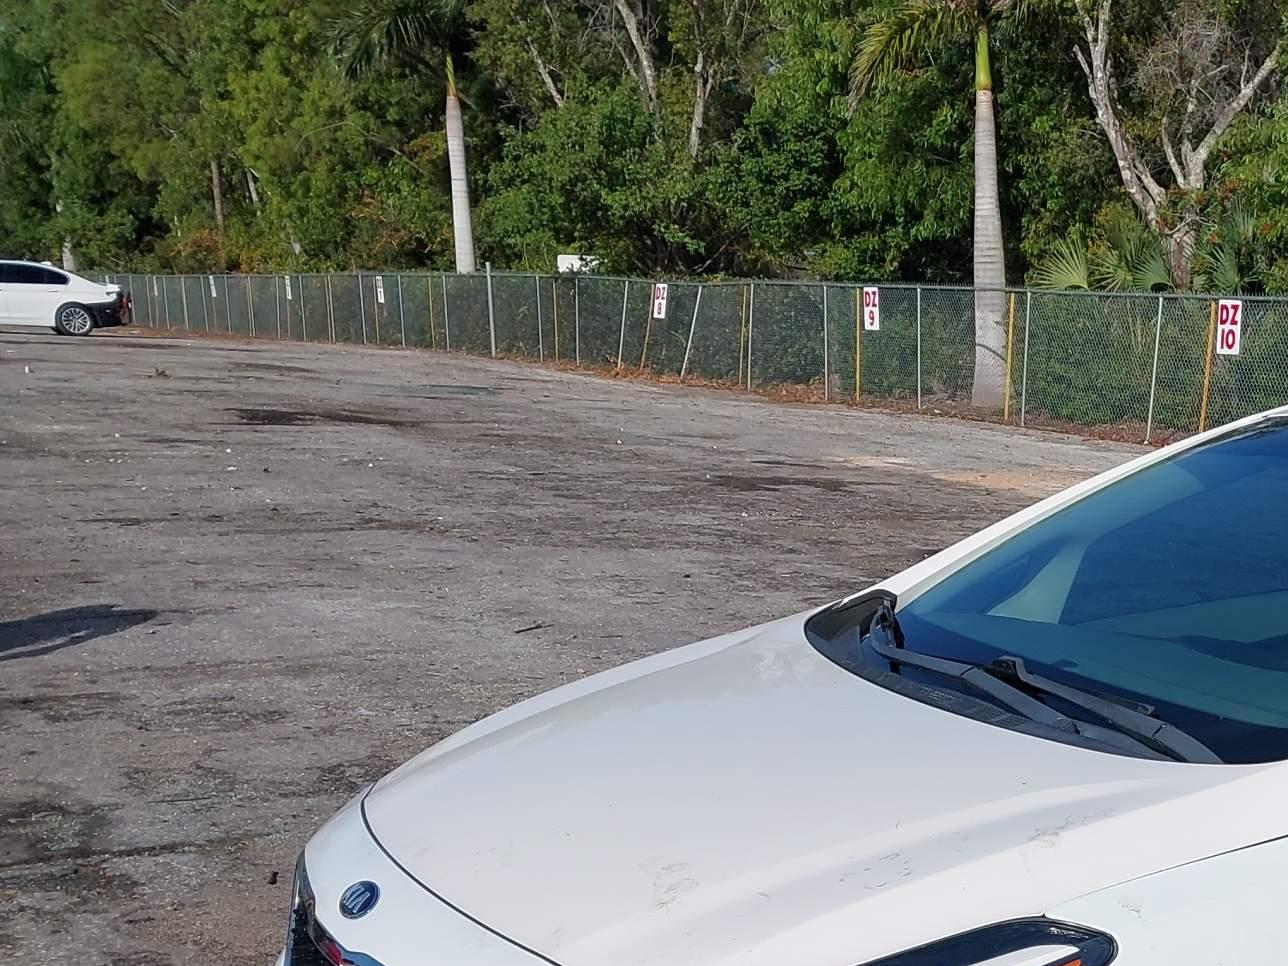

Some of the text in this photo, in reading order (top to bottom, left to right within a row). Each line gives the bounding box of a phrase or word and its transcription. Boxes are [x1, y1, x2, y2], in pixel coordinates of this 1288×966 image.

[656, 286, 666, 300] DZ
[865, 290, 877, 307] DZ
[869, 310, 874, 326] 9
[1220, 304, 1240, 325] DZ
[1220, 328, 1236, 350] 10
